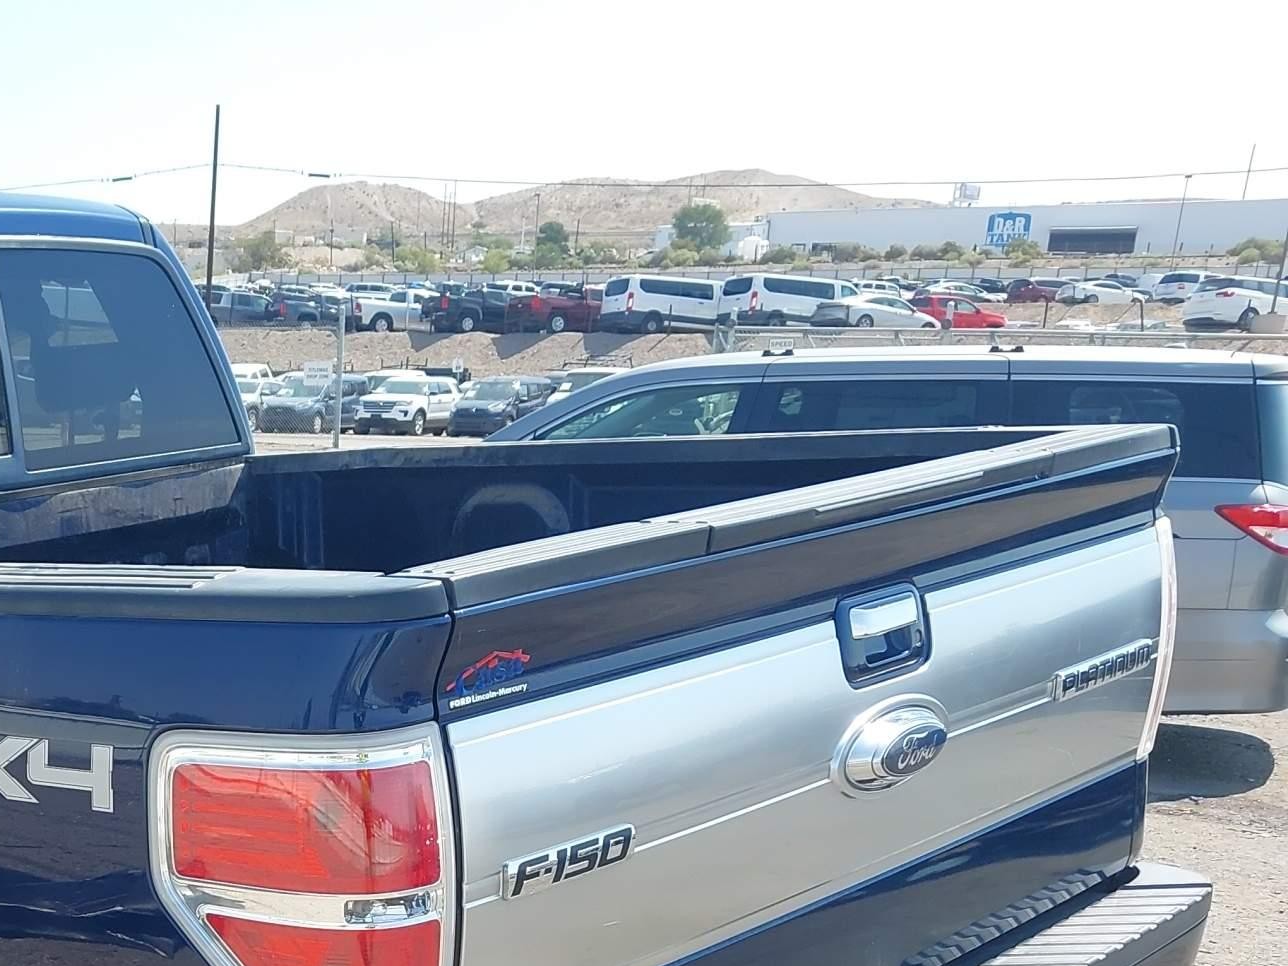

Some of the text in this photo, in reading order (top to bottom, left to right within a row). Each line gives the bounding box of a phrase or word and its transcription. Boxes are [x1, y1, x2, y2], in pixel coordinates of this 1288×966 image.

[993, 216, 1026, 233] D&R
[770, 340, 793, 348] SPEED
[1062, 643, 1152, 696] PLATINUM
[449, 683, 528, 709] FORD Lincoln-Mercury
[897, 730, 938, 770] Ford
[510, 826, 633, 898] F-150
